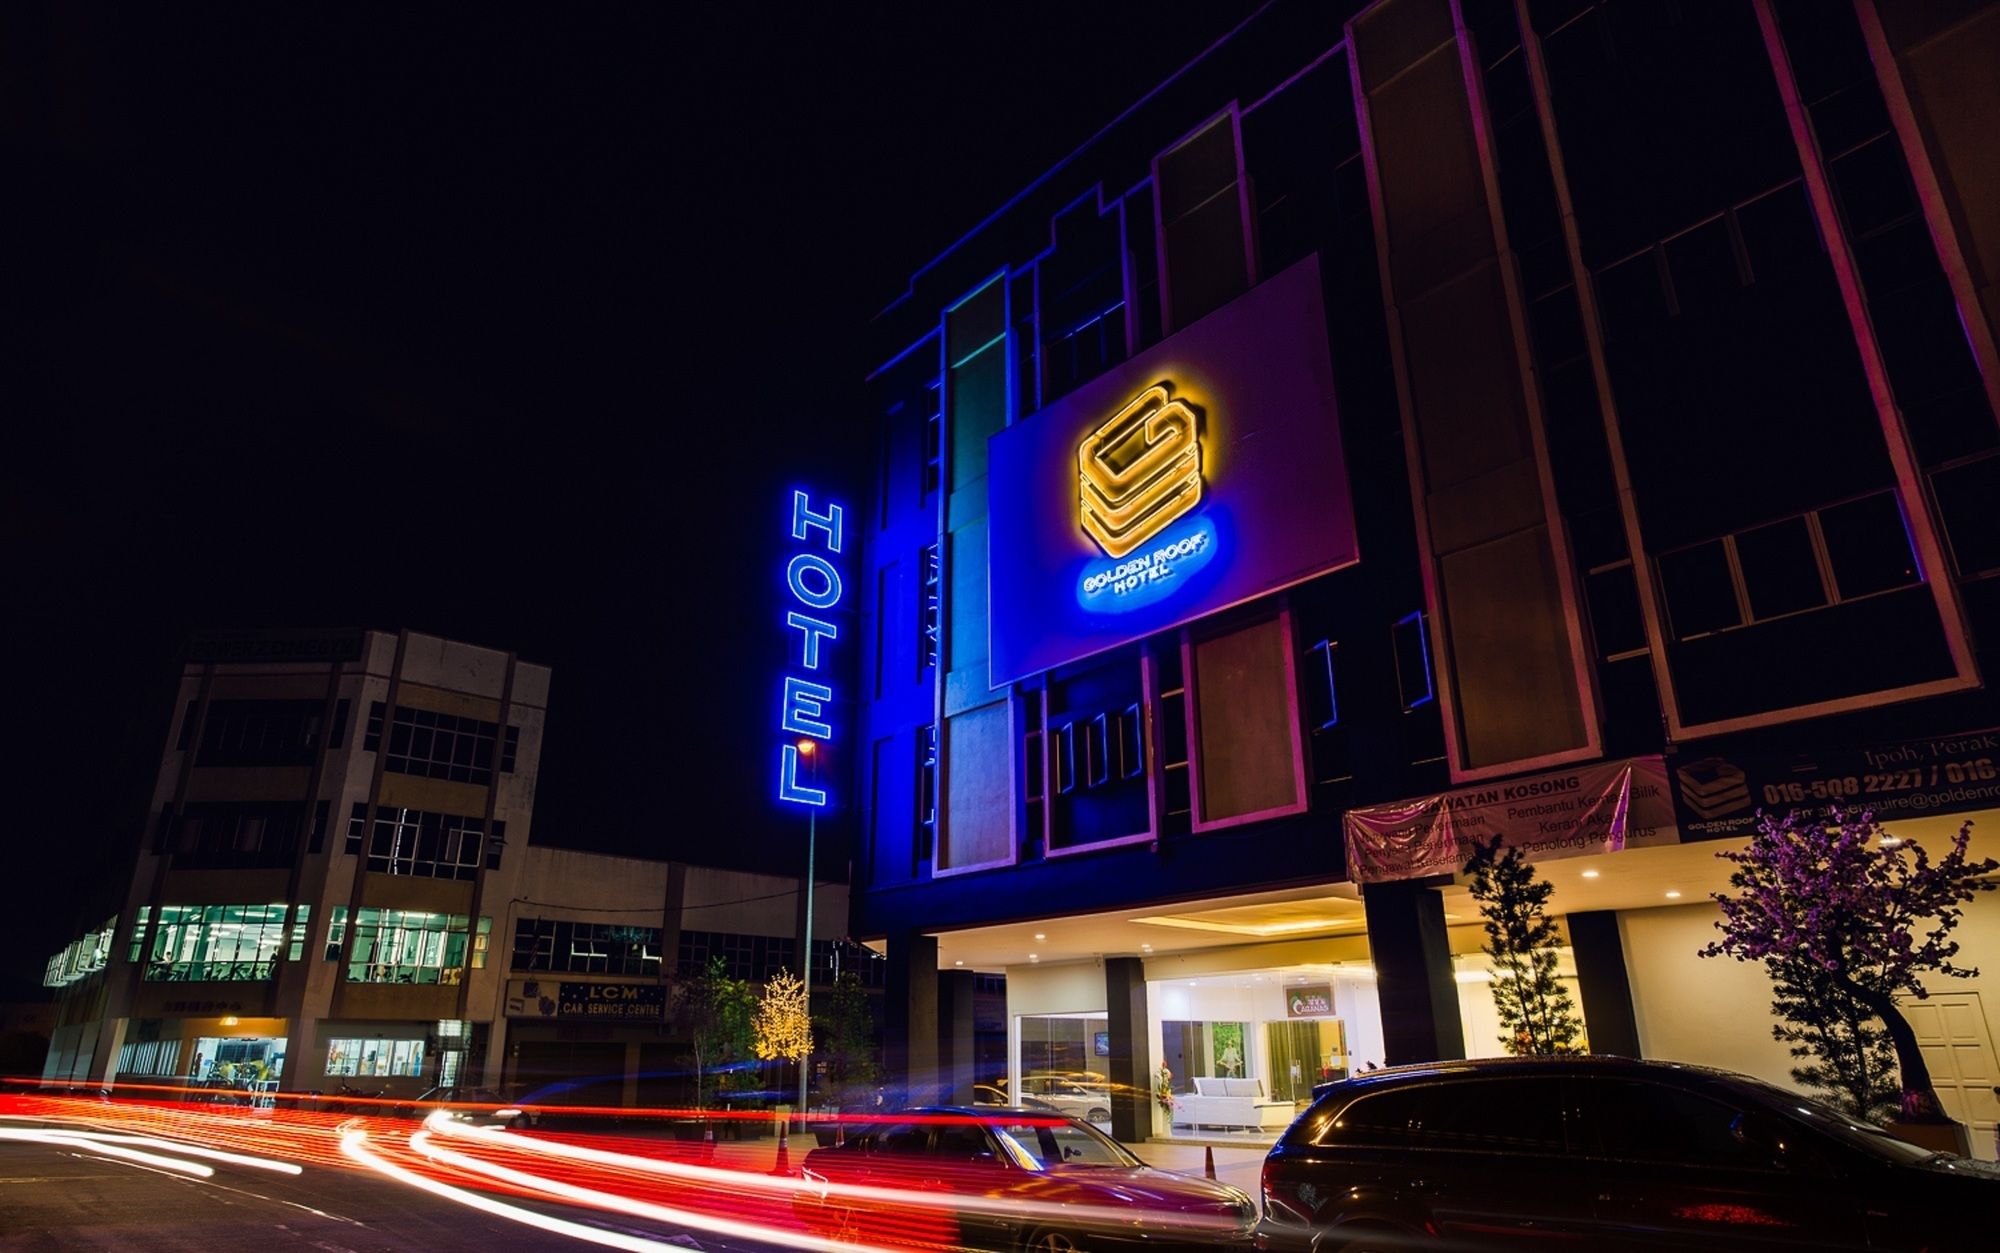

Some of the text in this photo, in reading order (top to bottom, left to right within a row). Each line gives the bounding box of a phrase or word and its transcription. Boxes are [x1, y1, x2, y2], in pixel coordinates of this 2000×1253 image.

[1083, 532, 1208, 593] GOLDEN ROOF
[1114, 564, 1171, 595] HOTEL
[780, 490, 842, 806] HOTEL
[1864, 735, 1999, 770] Ipoh, Perak
[1504, 777, 1580, 800] KOSONG
[1762, 776, 1860, 805] 016-508
[1863, 768, 1922, 793] 2227
[1930, 764, 1938, 787] /
[1507, 785, 1661, 820] Pembantu Kema Bilik
[1586, 812, 1630, 826] Aka
[1688, 819, 1727, 831] GOLDEN
[1706, 825, 1739, 834] HOTEL
[1522, 834, 1586, 853] Penolong
[589, 985, 639, 1000] LCM
[563, 1003, 660, 1015] CAR SERVICE CENTRE
